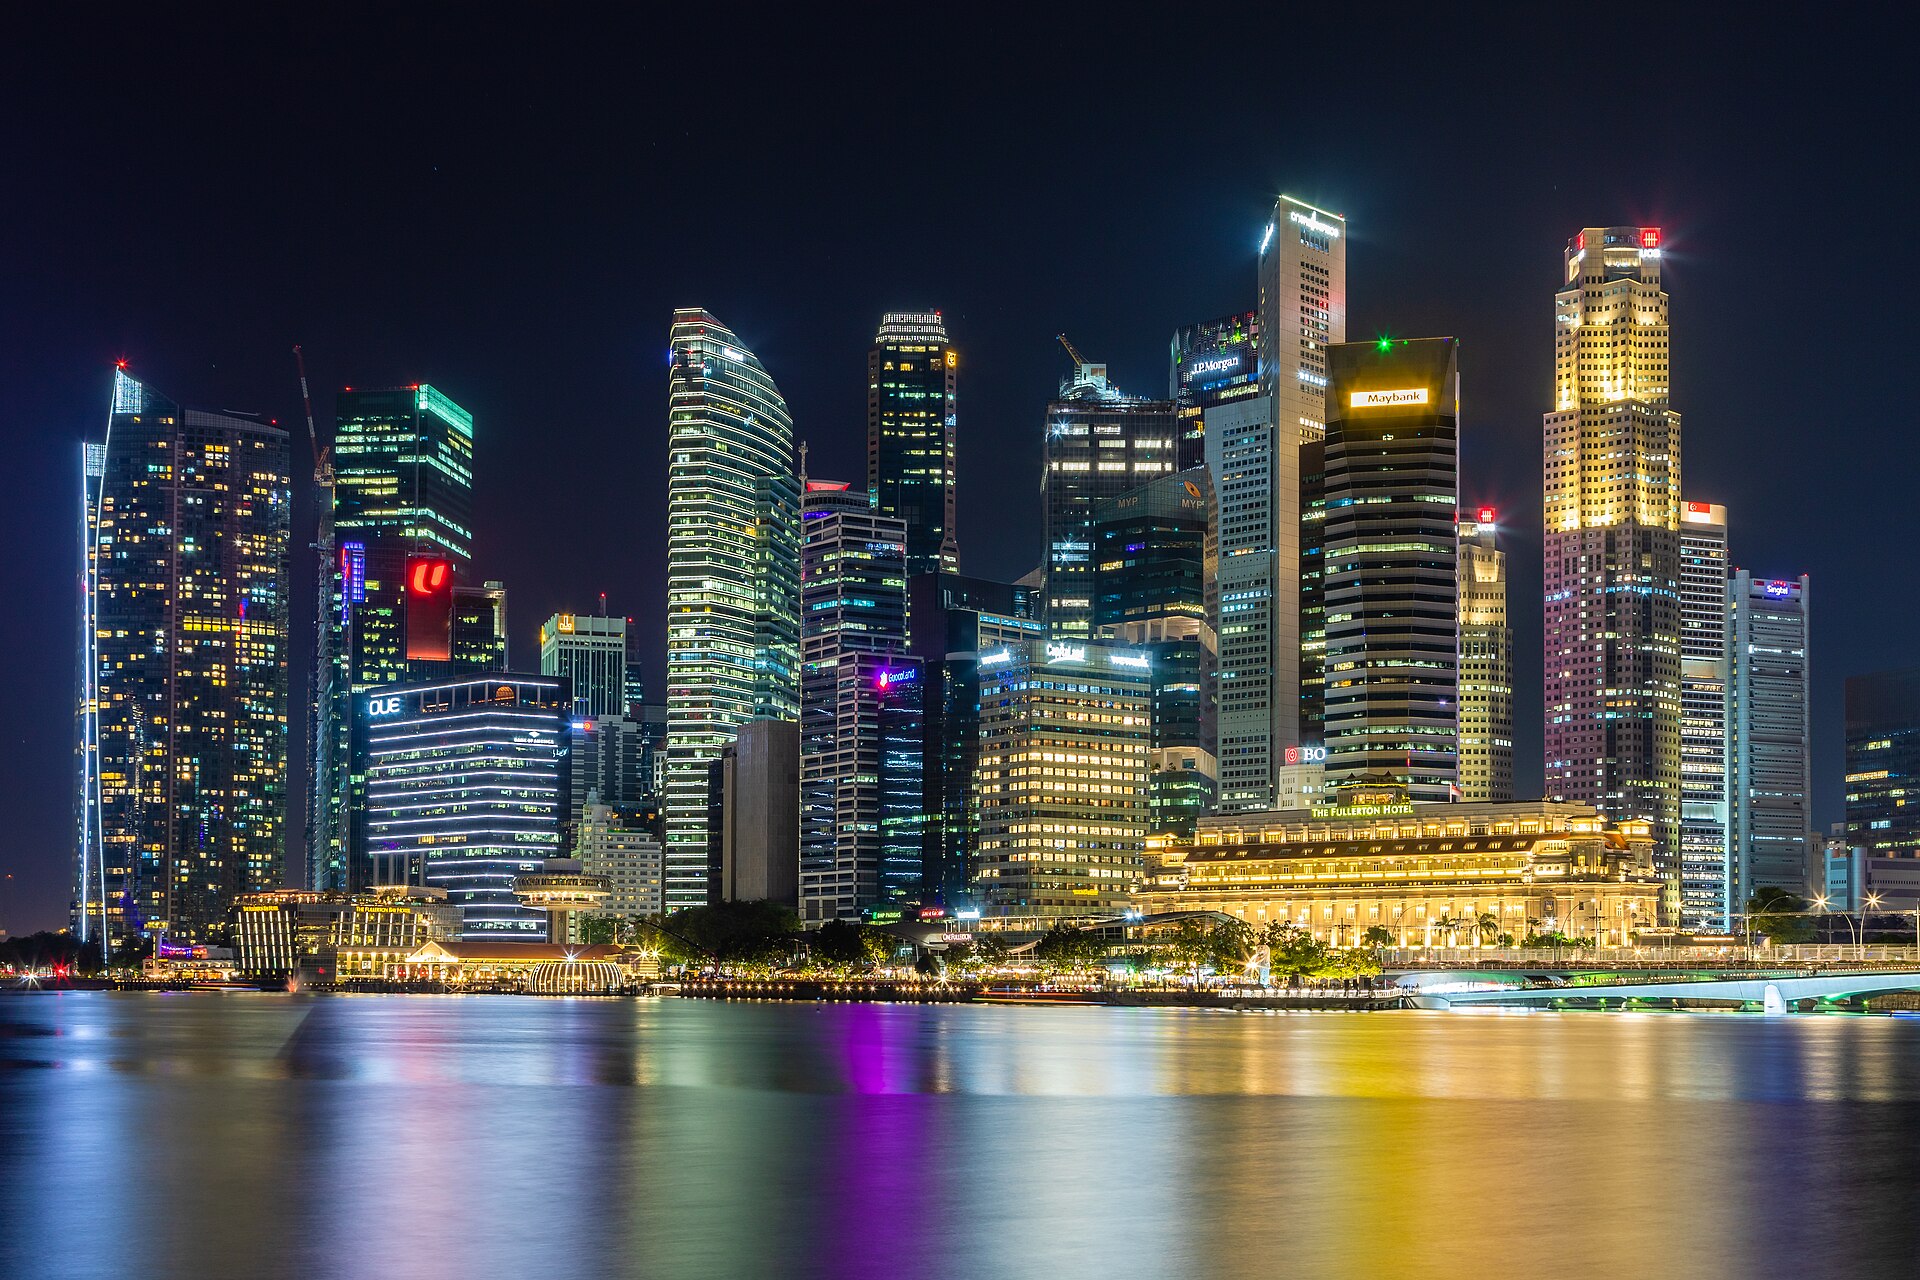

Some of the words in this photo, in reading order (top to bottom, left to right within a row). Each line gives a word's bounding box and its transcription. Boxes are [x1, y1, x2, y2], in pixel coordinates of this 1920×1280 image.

[1367, 391, 1420, 404] Maybank
[1118, 496, 1138, 509] MYP
[1181, 498, 1202, 510] MYP
[1766, 585, 1789, 596] Singtel
[369, 697, 400, 716] OUE
[1311, 808, 1329, 817] THE
[1330, 806, 1380, 817] FULLERTON
[1383, 804, 1414, 815] HOTEL
